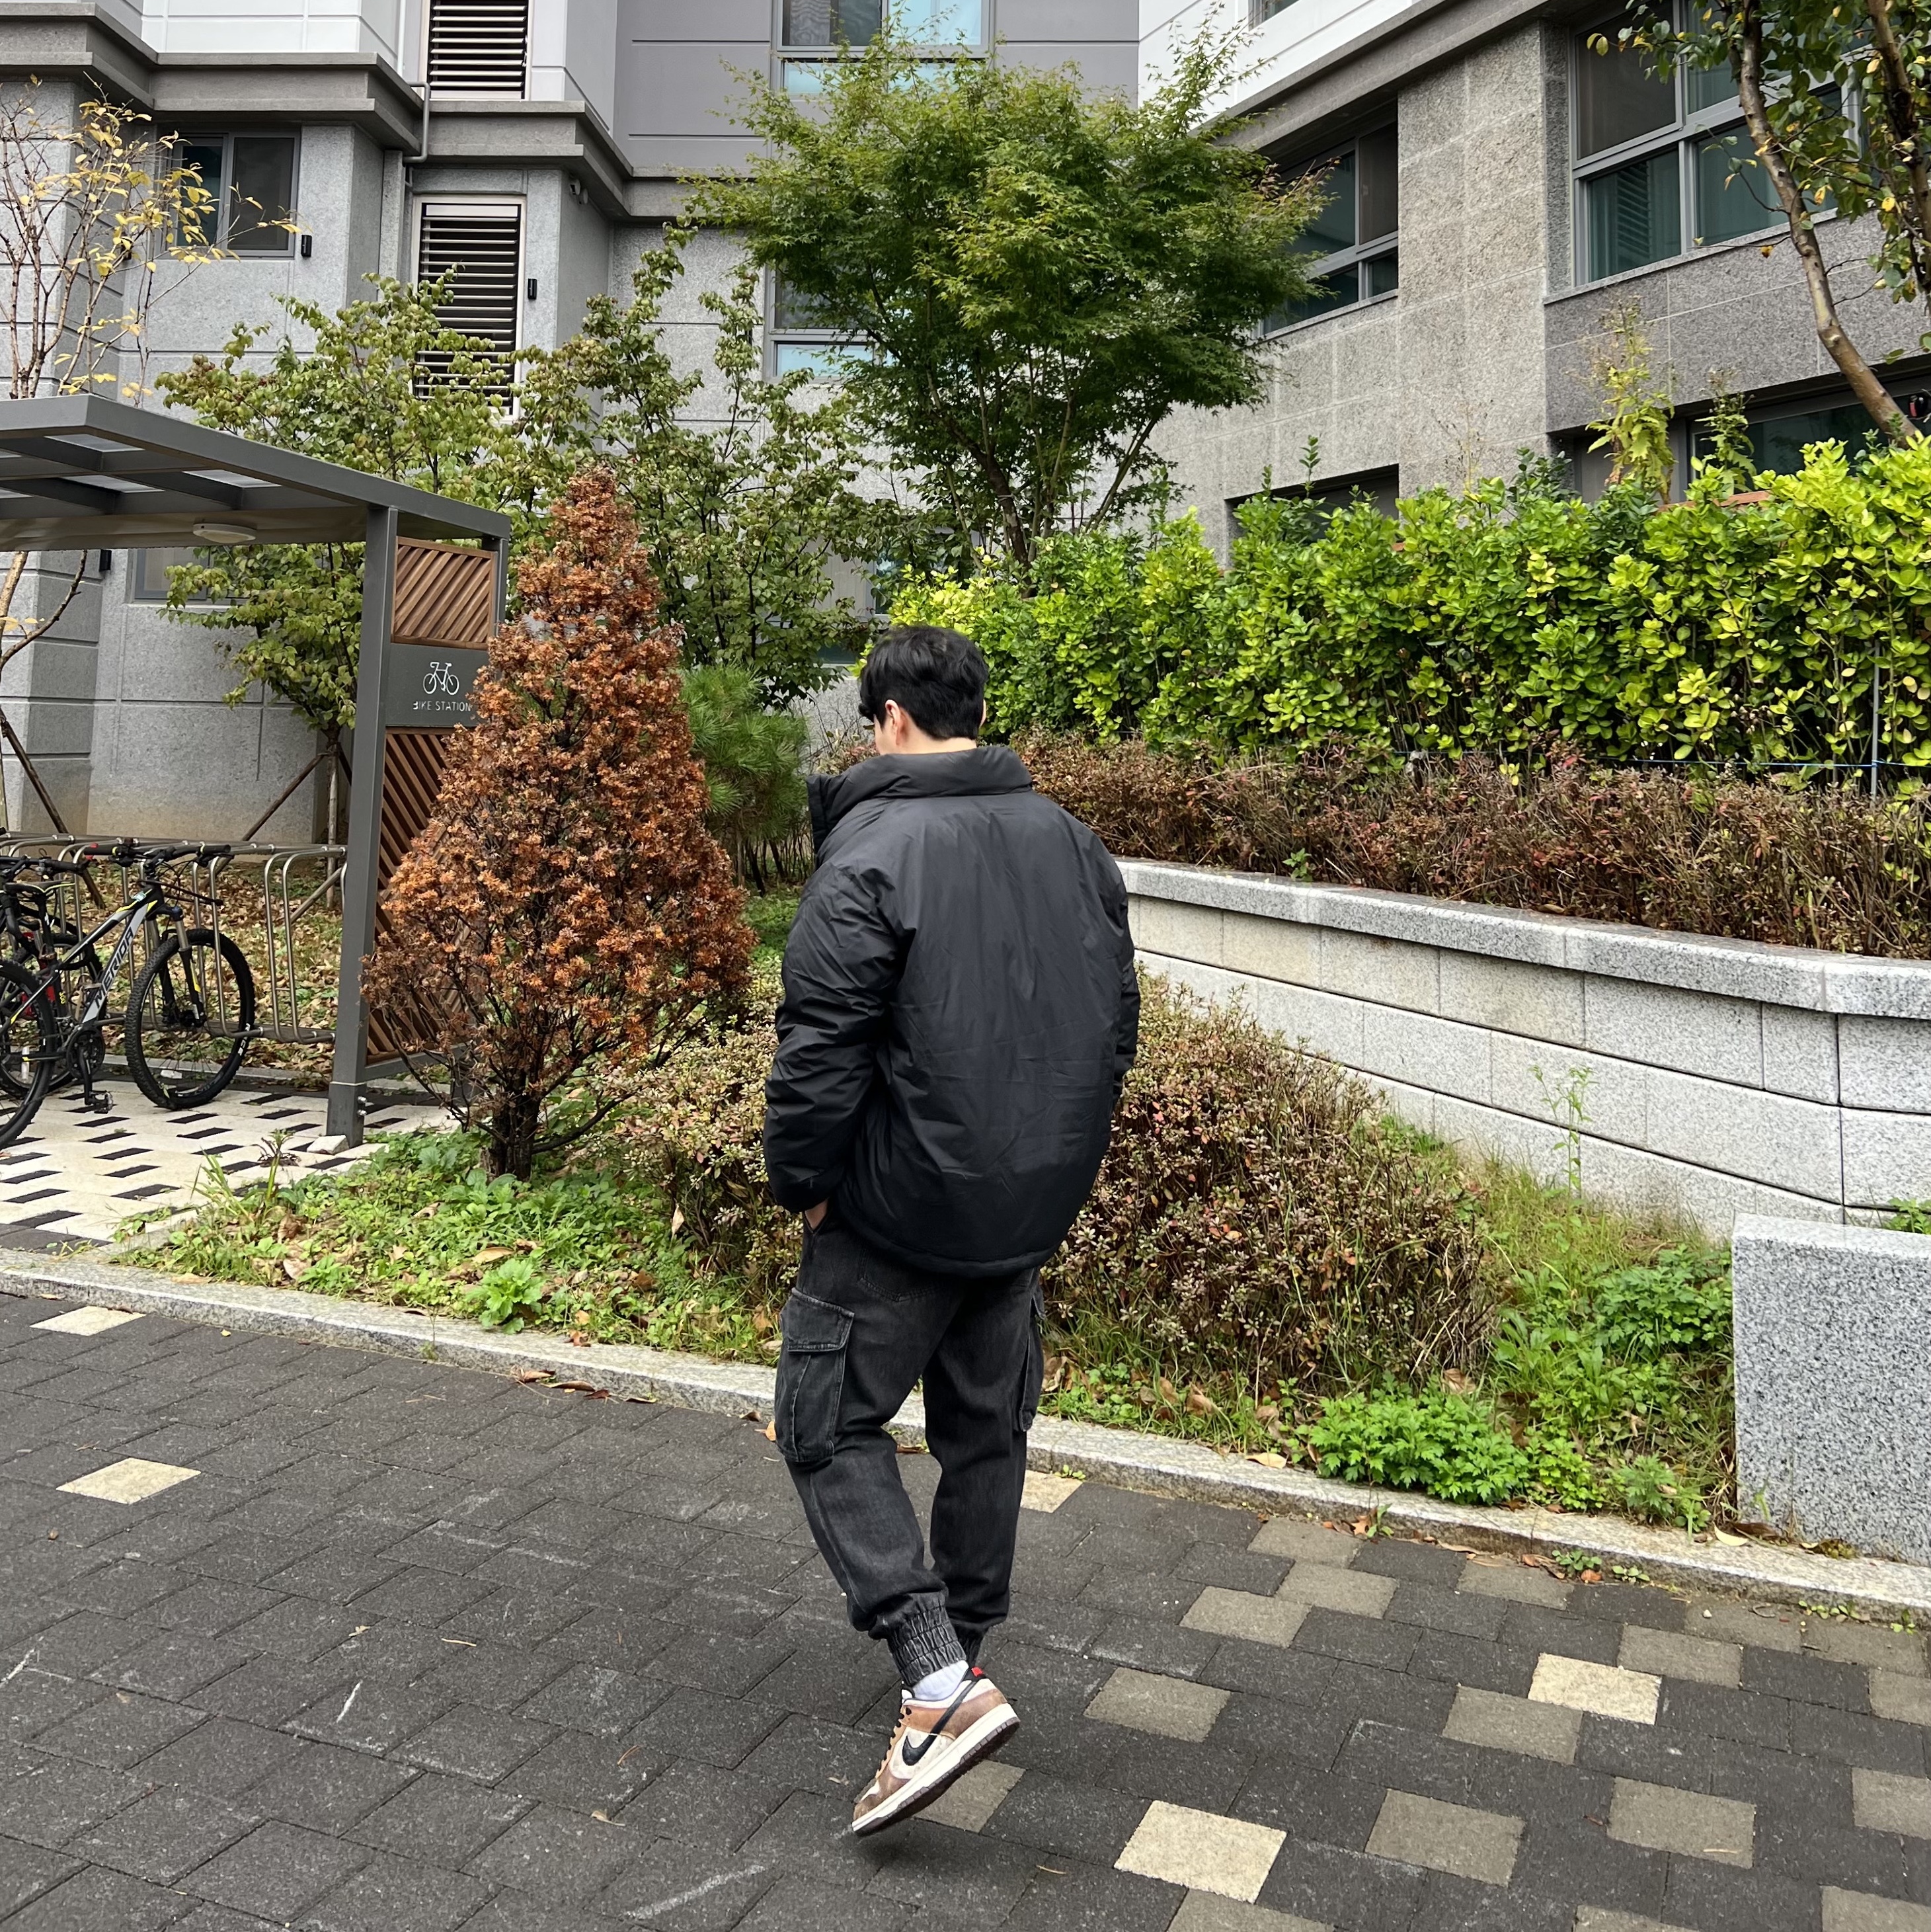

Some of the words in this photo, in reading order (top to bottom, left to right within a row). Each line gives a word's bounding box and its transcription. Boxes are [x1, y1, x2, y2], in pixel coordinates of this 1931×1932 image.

[413, 701, 432, 710] BIKE
[436, 701, 471, 711] STATION
[95, 926, 134, 1009] MERIDA
[237, 1022, 251, 1057] RCE
